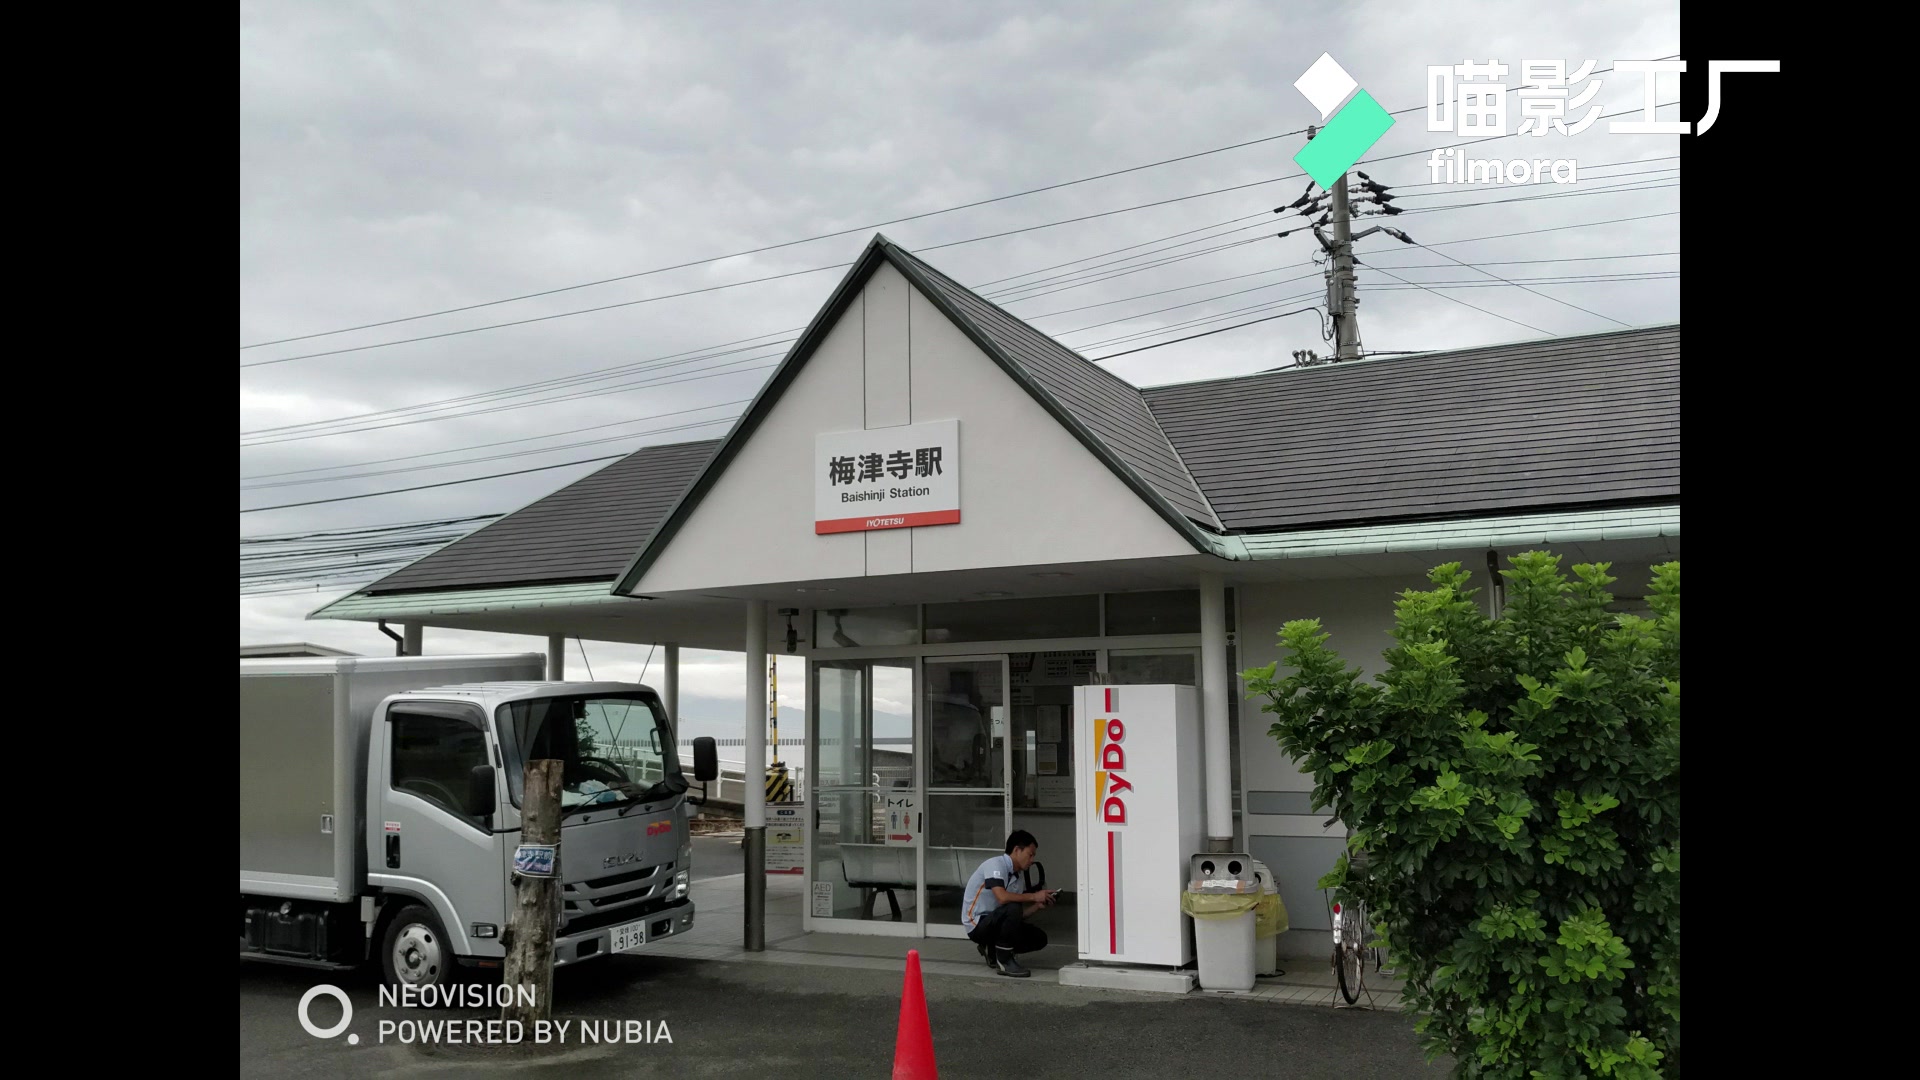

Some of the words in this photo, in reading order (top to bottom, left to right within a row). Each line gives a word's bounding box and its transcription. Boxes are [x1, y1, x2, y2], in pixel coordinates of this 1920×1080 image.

[829, 446, 943, 487] 梅津寺駅
[841, 489, 885, 503] Baishinji
[890, 486, 930, 499] Station
[866, 517, 905, 528] IYOTETSU
[1102, 718, 1133, 824] DyDo
[887, 798, 914, 808] トイレ
[814, 883, 832, 892] AED
[619, 931, 644, 950] 91-98
